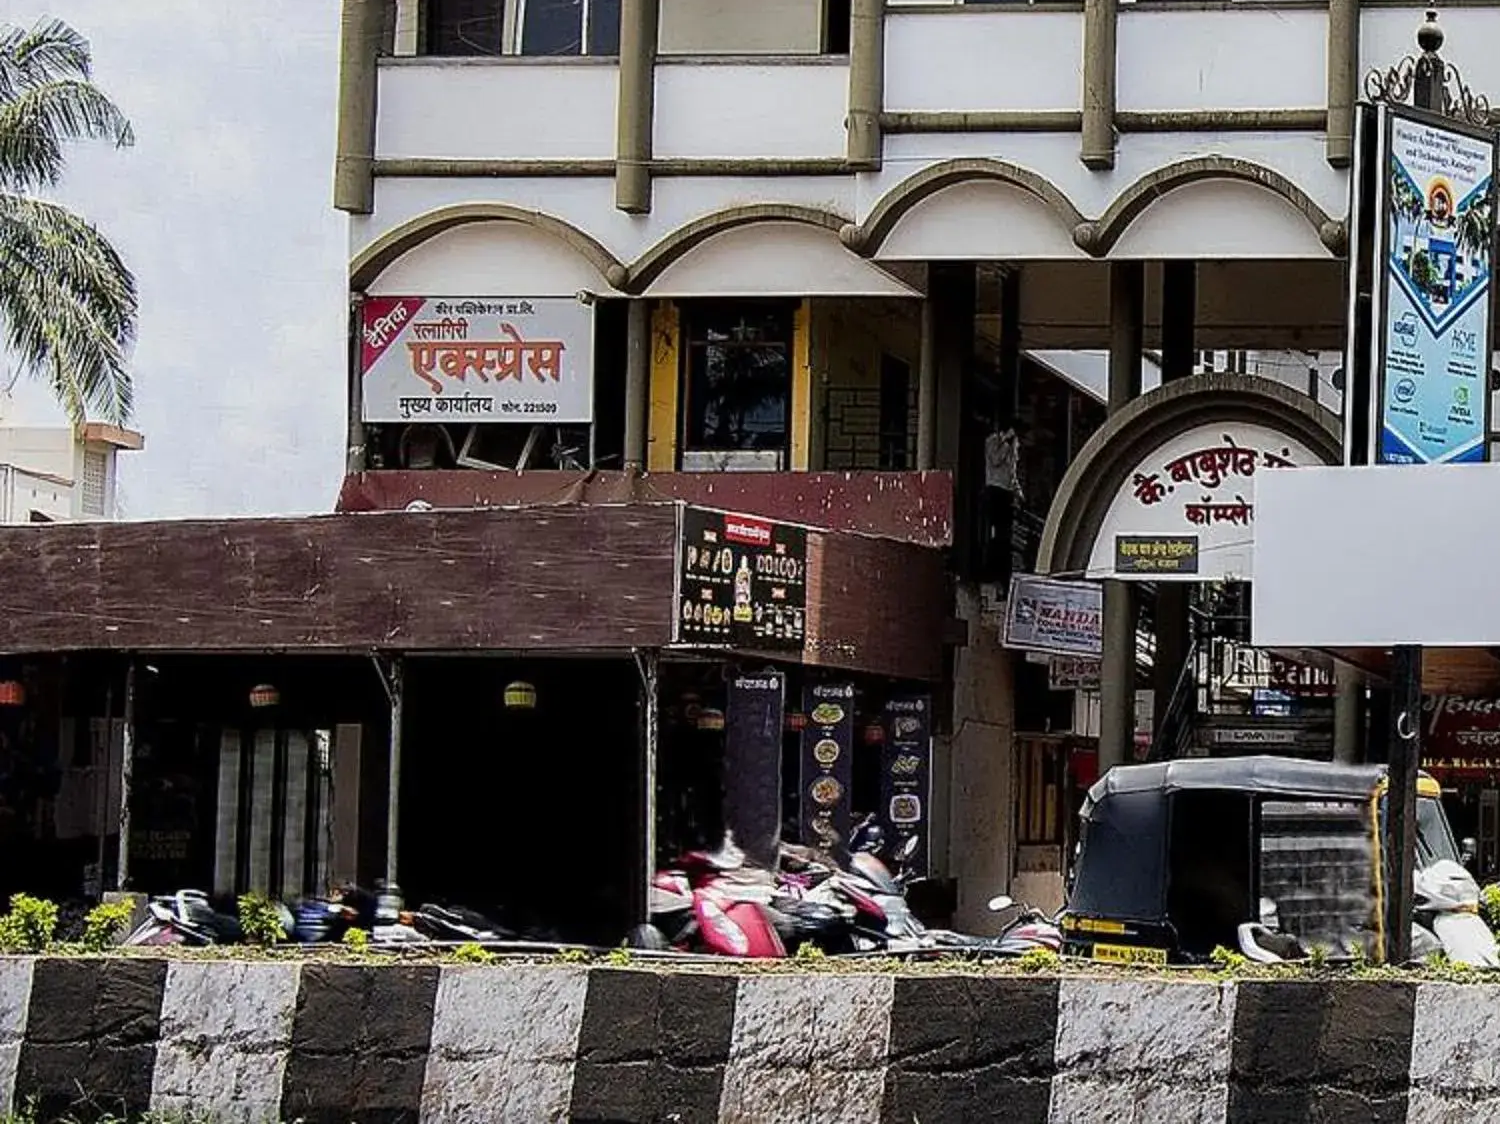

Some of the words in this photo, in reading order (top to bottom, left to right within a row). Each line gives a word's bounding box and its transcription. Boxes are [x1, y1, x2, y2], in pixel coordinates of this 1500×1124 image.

[365, 302, 408, 349] दैनिक
[399, 397, 432, 418] मुख्य
[435, 391, 493, 413] कार्यालय
[1185, 494, 1254, 526] कॉम्प्ले
